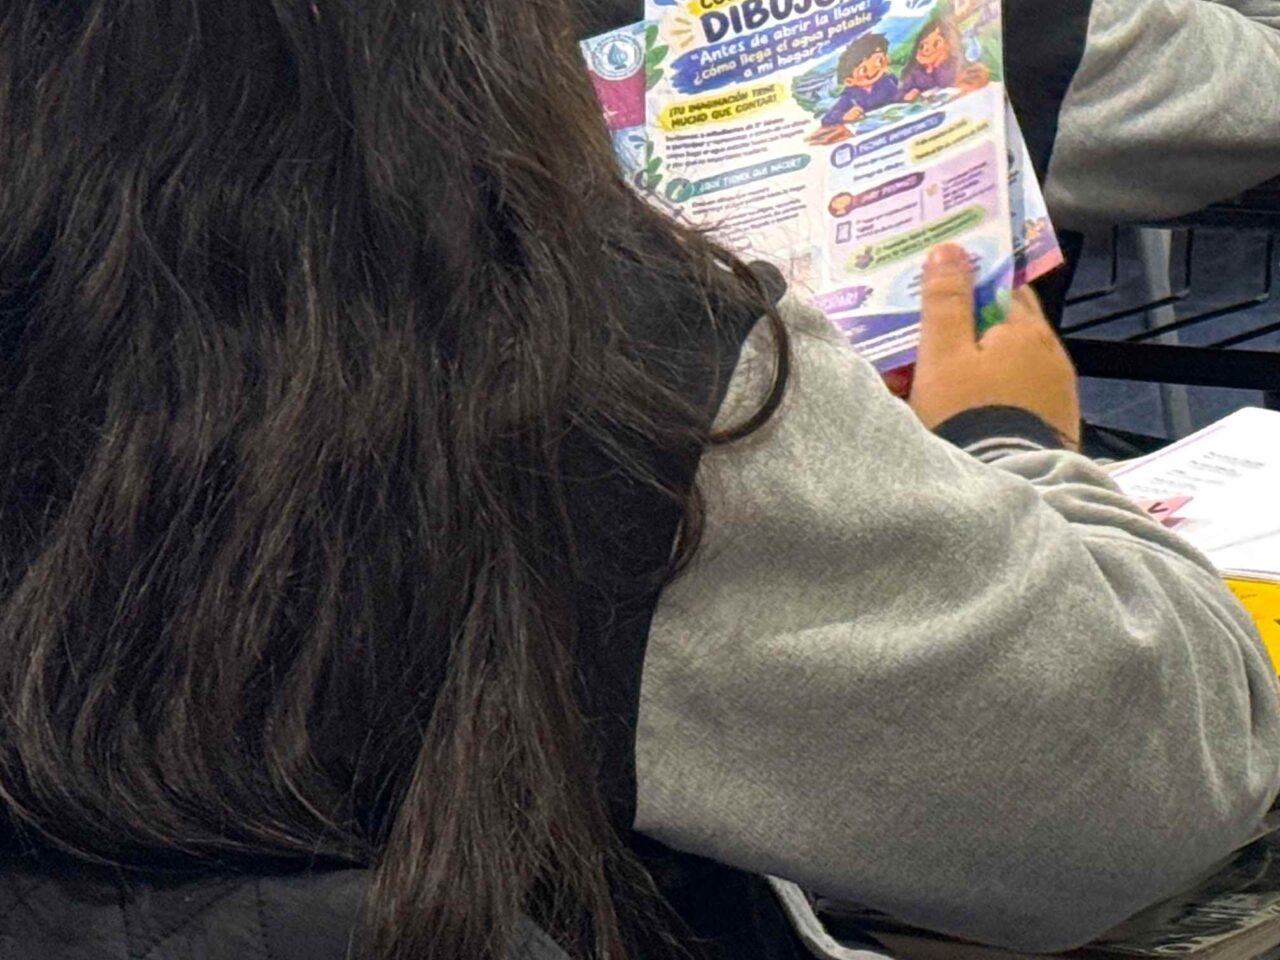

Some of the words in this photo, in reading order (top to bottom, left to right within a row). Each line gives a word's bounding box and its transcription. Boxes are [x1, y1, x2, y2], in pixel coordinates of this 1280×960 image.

[750, 34, 769, 48] de
[773, 20, 811, 41] abrir
[815, 13, 829, 28] la
[740, 48, 772, 67] llega
[775, 39, 788, 53] el
[791, 30, 824, 49] agua
[743, 68, 753, 79] a
[757, 60, 774, 75] mi
[711, 107, 733, 120] QUE
